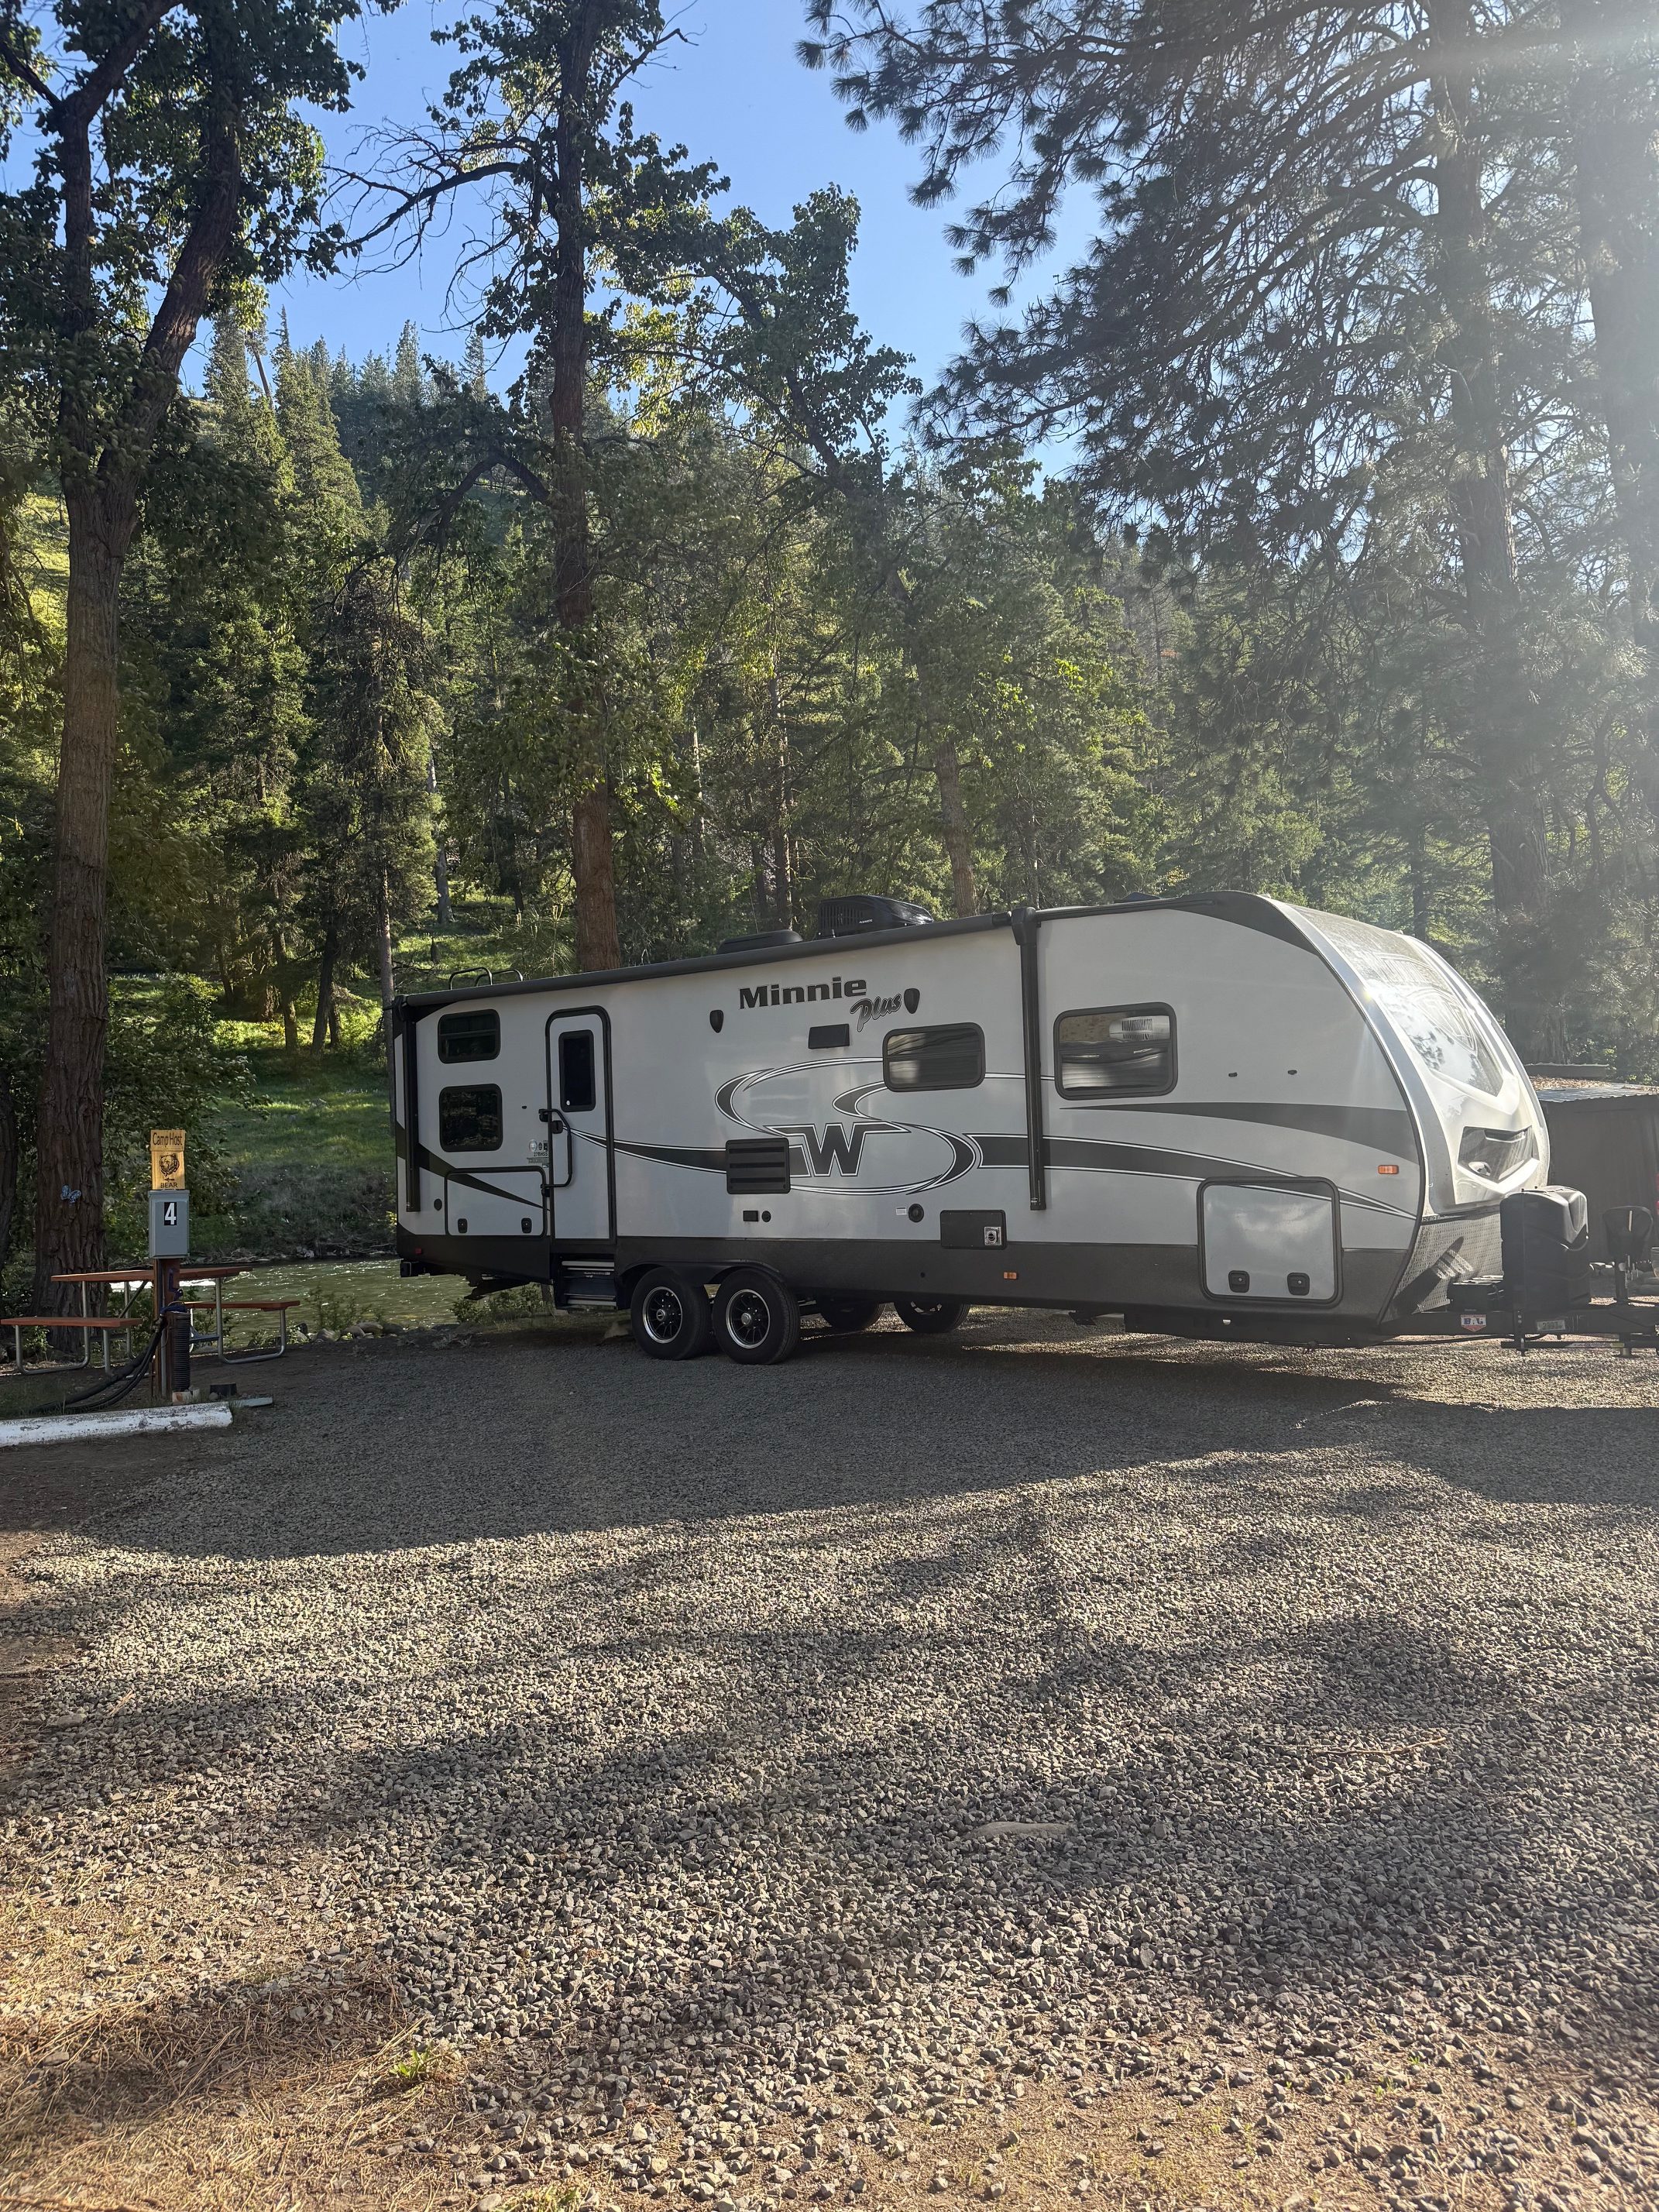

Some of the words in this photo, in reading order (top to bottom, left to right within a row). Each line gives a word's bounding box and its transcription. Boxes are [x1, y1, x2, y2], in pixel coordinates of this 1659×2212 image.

[739, 976, 867, 1009] Minnie
[850, 994, 902, 1032] Plus
[153, 1132, 169, 1146] Camp
[170, 1132, 183, 1146] Host
[164, 1202, 177, 1225] 4
